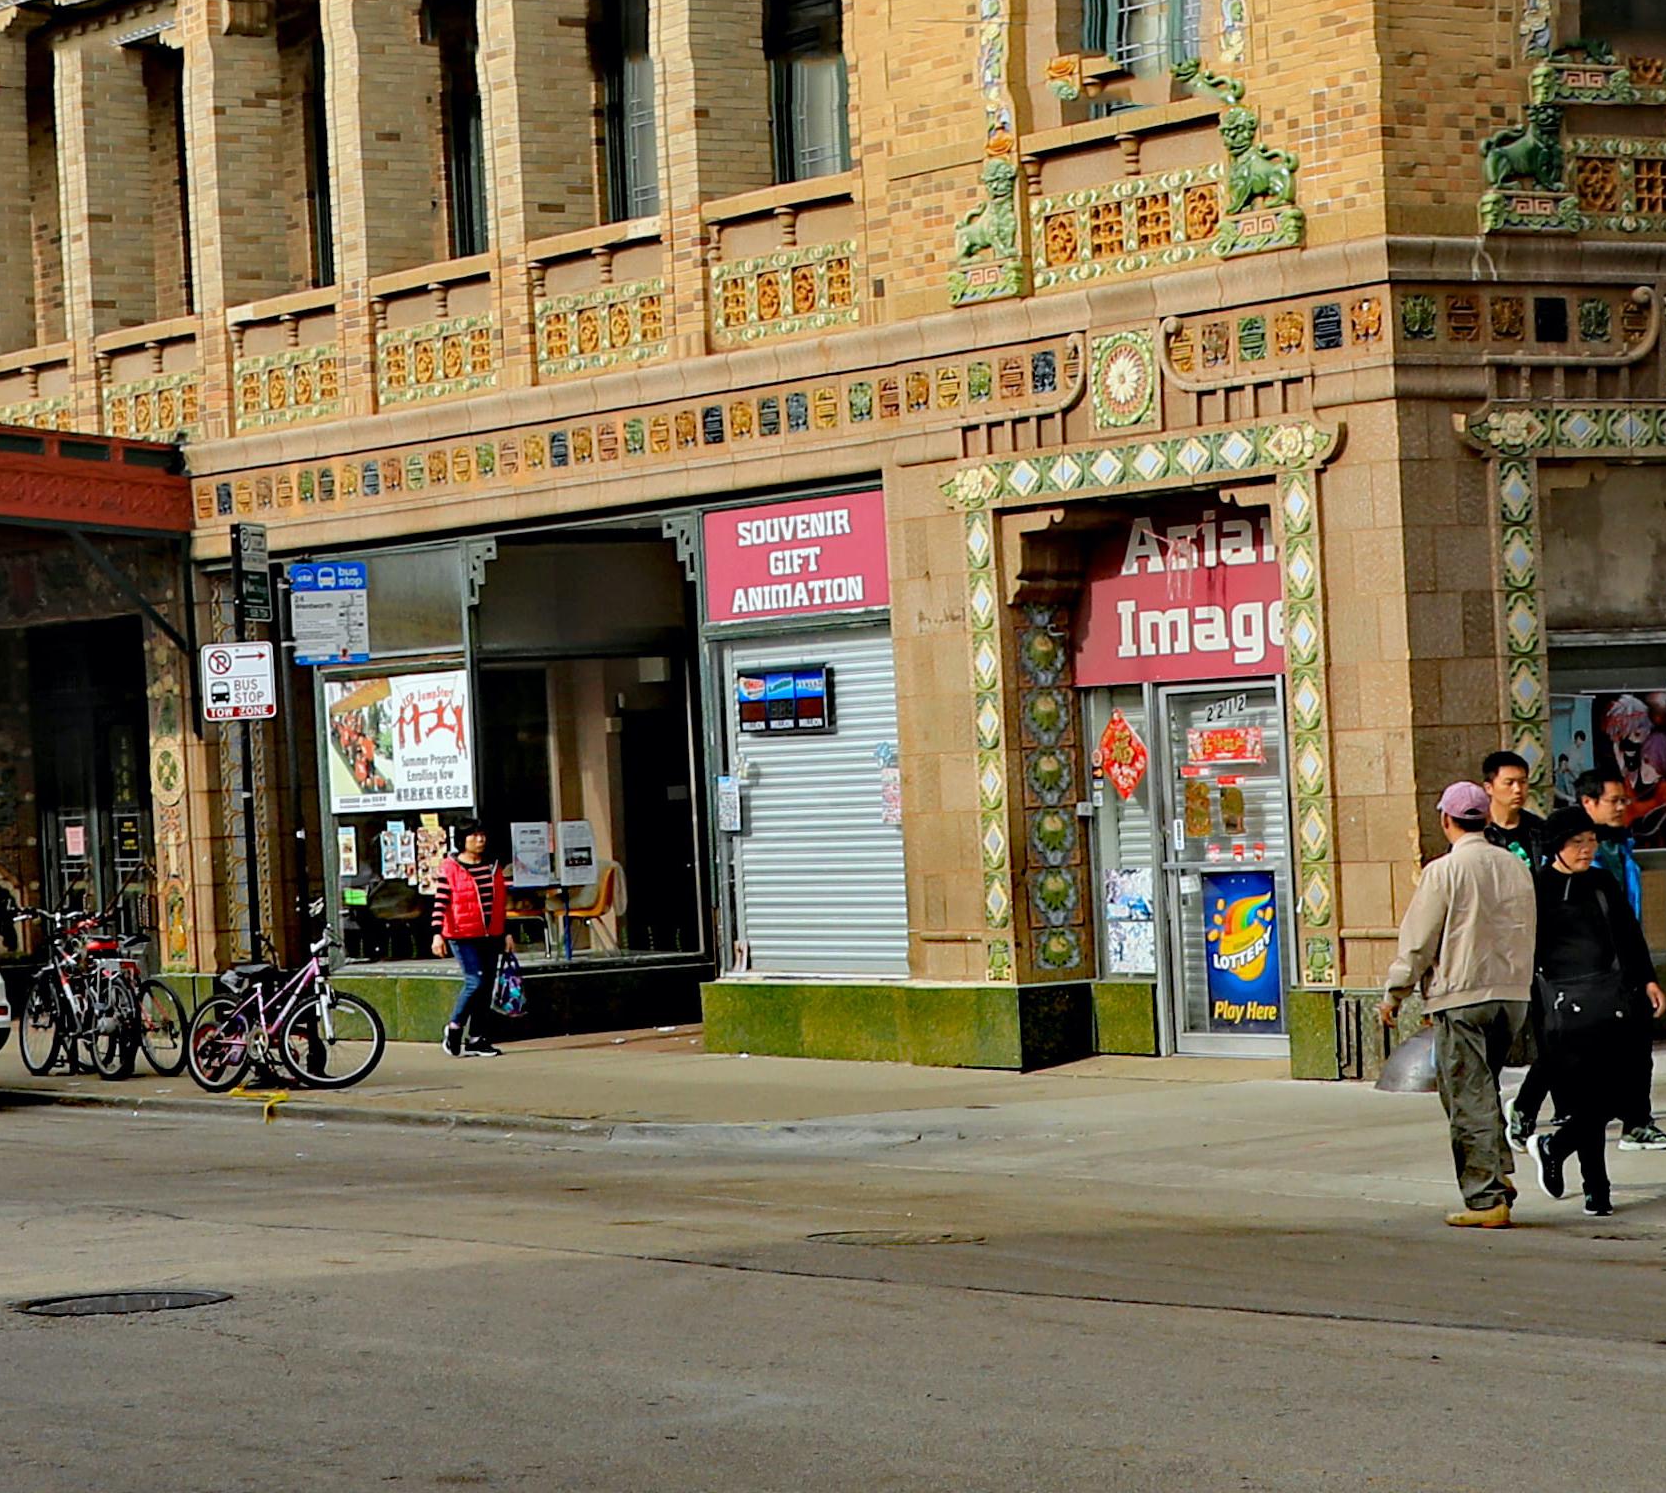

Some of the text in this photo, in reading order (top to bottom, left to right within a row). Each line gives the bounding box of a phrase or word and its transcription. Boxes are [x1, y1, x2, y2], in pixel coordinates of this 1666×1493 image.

[737, 509, 851, 547] SOUVENIR
[769, 546, 821, 576] GIFT
[338, 567, 358, 576] bus
[339, 577, 363, 588] stop
[732, 575, 864, 613] ANIMATION
[234, 679, 258, 692] BUS
[235, 692, 265, 704] STOP
[211, 706, 269, 718] TOW ZONE
[1206, 693, 1247, 722] 2212
[402, 754, 458, 768] Summer Program
[407, 769, 454, 784] Enrolling Now
[1213, 924, 1272, 969] LOTTERY
[1214, 1000, 1277, 1024] Play Here
